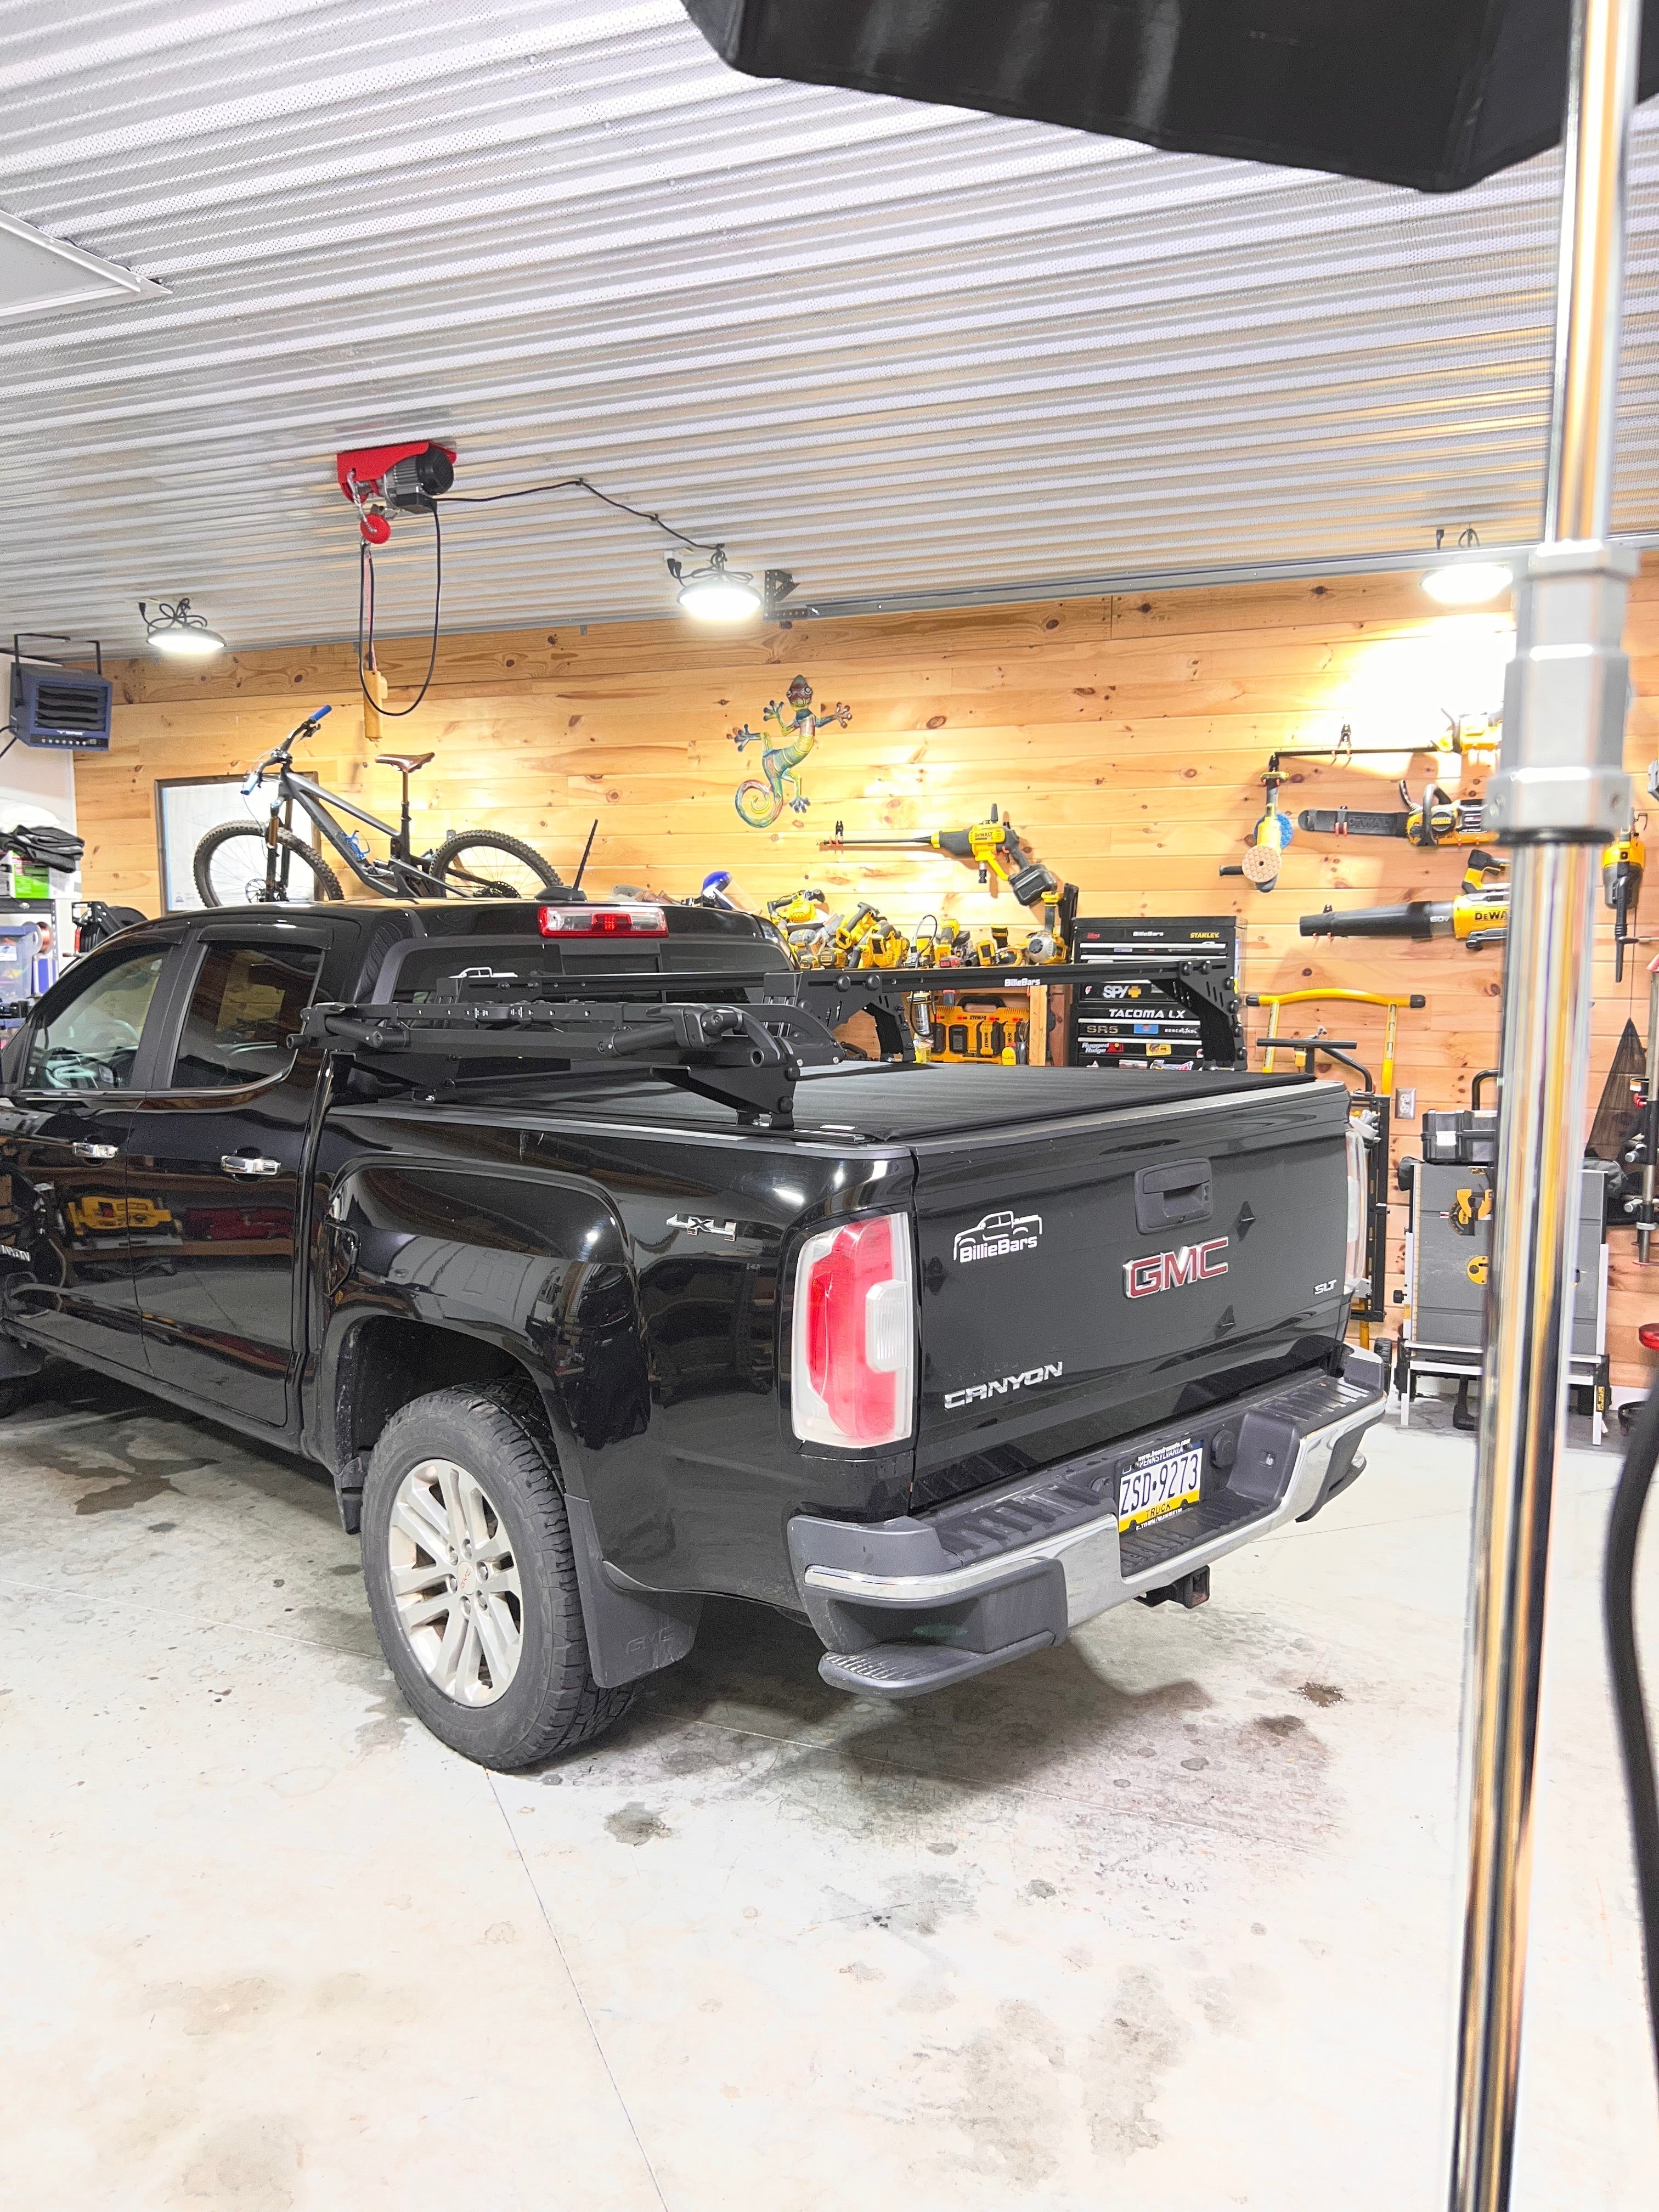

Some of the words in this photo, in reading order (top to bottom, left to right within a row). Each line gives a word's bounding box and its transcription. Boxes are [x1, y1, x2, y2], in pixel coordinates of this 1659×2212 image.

[1004, 978, 1041, 987] BillieBars
[1108, 1009, 1165, 1019] TACOMA
[1168, 1010, 1186, 1019] LX
[1086, 1025, 1119, 1034] SR5
[960, 1235, 1038, 1263] BillieBars
[1123, 1236, 1229, 1299] GMC
[1313, 1279, 1338, 1295] SLT
[944, 1361, 1063, 1410] CANYON
[1139, 1444, 1184, 1469] PENNSYLVANIA
[1146, 1501, 1171, 1520] TRUCK
